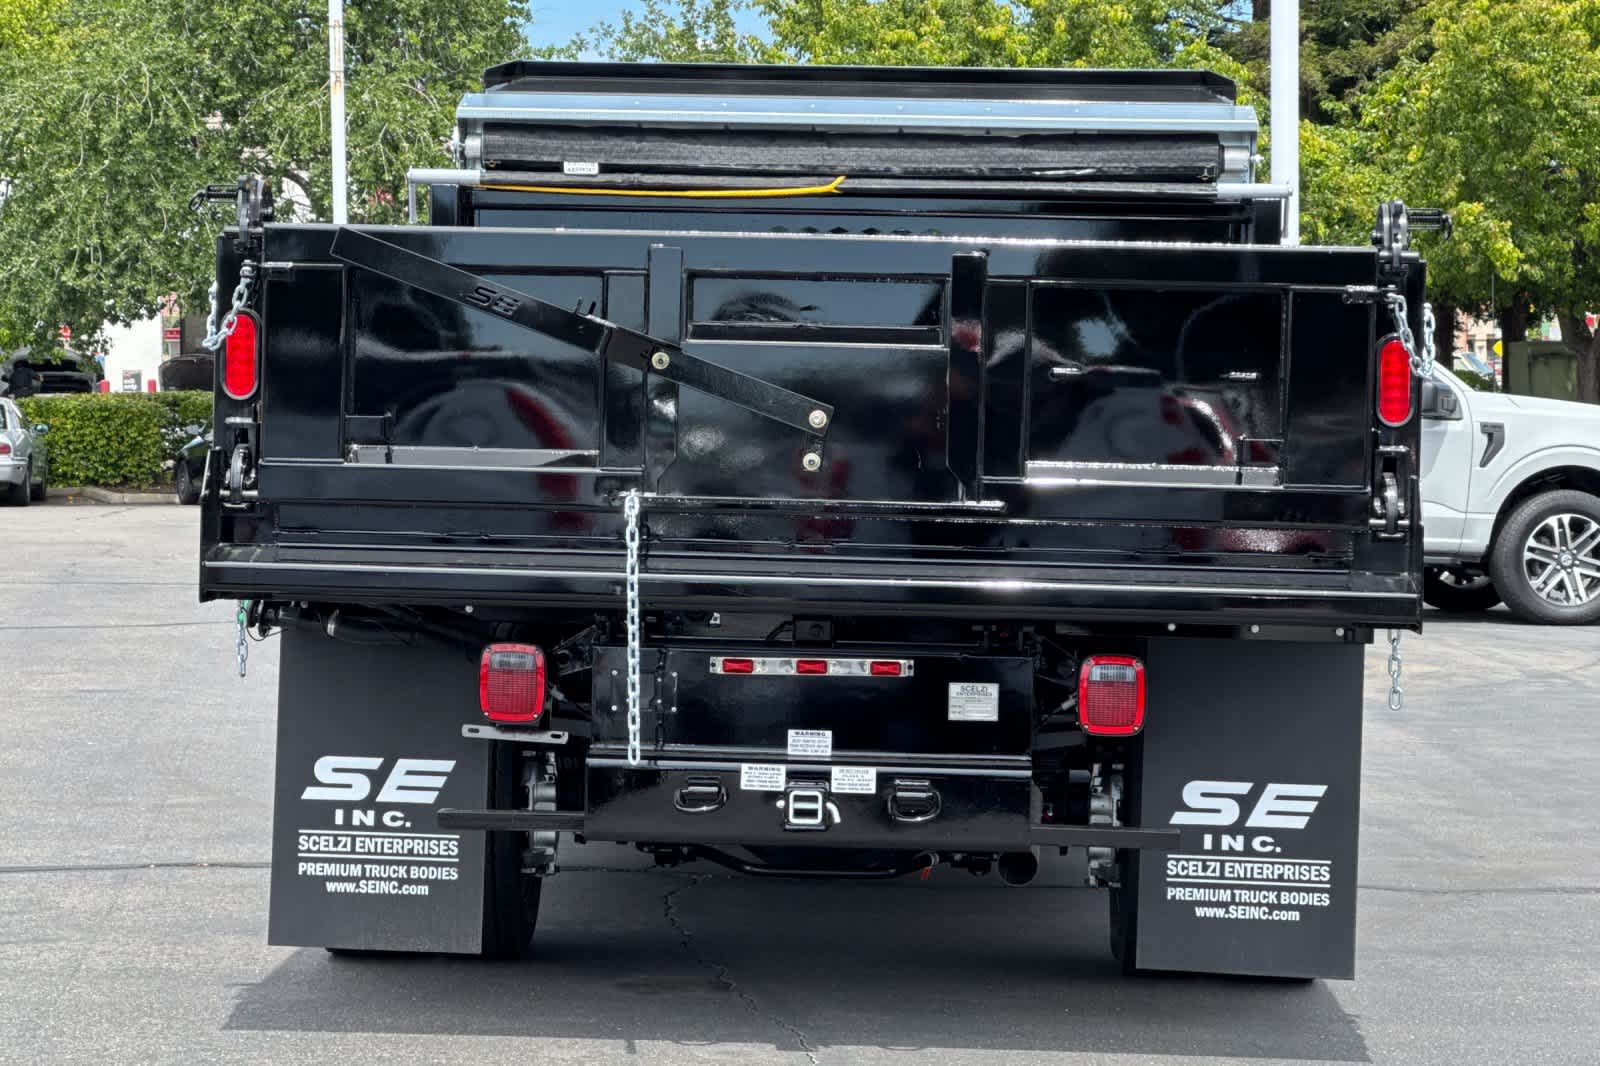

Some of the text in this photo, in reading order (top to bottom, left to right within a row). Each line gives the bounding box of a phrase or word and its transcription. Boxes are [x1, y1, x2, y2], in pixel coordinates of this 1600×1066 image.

[301, 755, 456, 804] SE
[1168, 780, 1328, 829] SE
[335, 808, 412, 828] INC.
[298, 835, 459, 856] SCELZI ENTERPRISES
[1203, 833, 1282, 853] INC.
[298, 862, 459, 880] PREMIUM TRUCK BODIES
[1166, 860, 1330, 881] SCELZI ENTERPRISES
[326, 880, 429, 895] www.SEINC.com
[1166, 887, 1330, 906] PREMIUM TRUCK BODIES
[1195, 905, 1300, 921] www.SEINC.com
